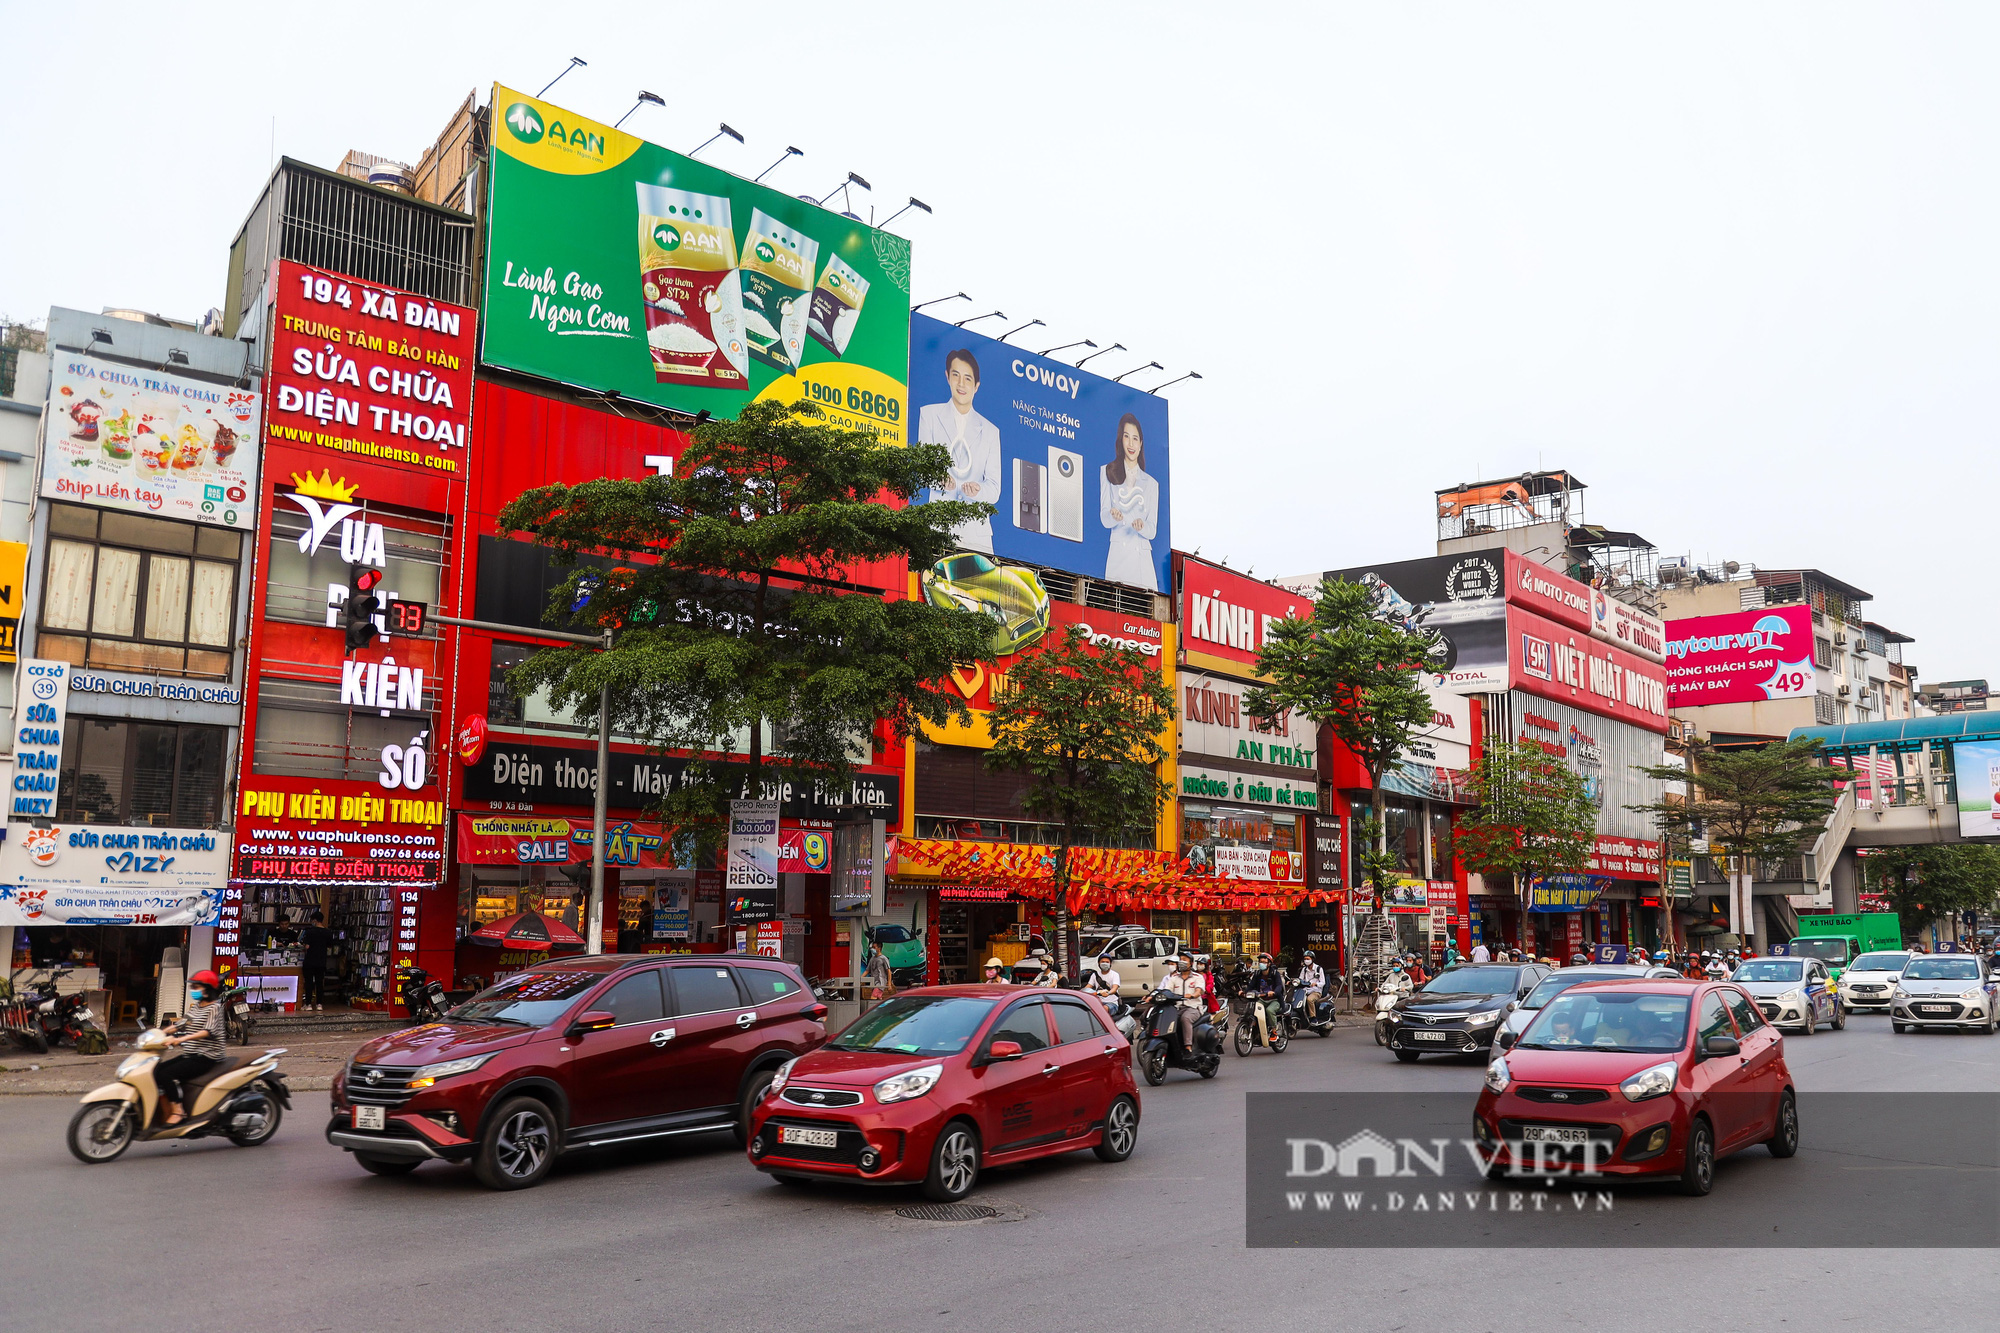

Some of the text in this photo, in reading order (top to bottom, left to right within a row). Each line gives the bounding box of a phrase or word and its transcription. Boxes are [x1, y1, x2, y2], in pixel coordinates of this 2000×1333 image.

[548, 120, 605, 156] AAN
[683, 230, 722, 250] AAN
[776, 253, 804, 275] AAN
[502, 261, 603, 301] Lành Gạo
[666, 287, 690, 301] ST24
[841, 284, 860, 301] AAN
[301, 274, 460, 336] 194 XÃ ĐÀN
[529, 293, 630, 332] Ngon Cơm
[283, 314, 459, 371] TRUNG TÂM BẢO HÀN
[68, 363, 221, 404] SỮA CHUA TRÂN CHÂU
[292, 343, 454, 409] SỬA CHỮA
[802, 380, 900, 421] 1900 6869
[277, 384, 465, 451] ĐIỆN THOẠI
[1012, 400, 1080, 428] NÂNG TẦM SỐNG
[829, 415, 852, 428] GẠO
[883, 429, 899, 441] PHÍ
[1019, 415, 1075, 440] TRỌN AN TÂM
[56, 478, 193, 510] Ship Liền tay cùng
[1464, 558, 1479, 567] 2017
[1462, 570, 1481, 580] MOTO2
[1457, 588, 1487, 597] CHAMPIONS
[1463, 580, 1481, 589] WORLD
[1534, 578, 1588, 614] MOTO ZONE
[393, 603, 421, 631] 73
[1191, 589, 1254, 652] KÍNH
[1123, 622, 1160, 638] Car Audio
[1530, 641, 1547, 669] SH
[1705, 661, 1746, 674] KHÁCH
[1750, 659, 1773, 671] SẠN
[1449, 672, 1487, 681] TOTAL
[1554, 637, 1665, 717] VIỆT NHẬT MOTOR
[37, 683, 53, 694] 39
[72, 674, 241, 704] SỮA CHUA TRÂN CHÂU
[341, 657, 424, 717] KIỆN
[1680, 681, 1705, 692] MÁY
[1708, 679, 1731, 690] BAY
[26, 703, 57, 723] SỮA
[19, 728, 60, 746] CHUA
[18, 750, 58, 770] TRÂN
[378, 730, 430, 791] SỐ
[1236, 740, 1314, 768] AN PHÁT
[14, 772, 56, 792] CHÂU
[493, 753, 543, 794] Điện
[555, 757, 598, 798] thoạ
[633, 764, 673, 800] Máy
[852, 781, 885, 816] kiện
[1183, 774, 1316, 807] KHÔNG Ở ĐÂU RẺ HƠN
[14, 798, 53, 814] MIZY
[242, 788, 444, 831] PHỤ KIỆN ĐIỆN THOẠI
[489, 801, 533, 812] 190 Xã Đàn
[733, 801, 778, 809] OPPO Reno5
[69, 829, 215, 851] SỮA CHUA TRÂN CHÂU
[252, 829, 436, 846] www. vuaphukienso.com
[239, 843, 441, 860] Cơ sở 194 Xã Đàn 0967 68 6666
[519, 842, 567, 859] SALE
[1217, 850, 1267, 863] MUA BÁN SỬA CHỮA
[1599, 840, 1612, 855] BẢO
[1612, 841, 1633, 857] DƯỠNG
[1271, 855, 1287, 865] ĐỒNG
[252, 859, 425, 881] PHỤ KIỆN ĐIỆN THOẠI
[1276, 866, 1285, 877] HỒ
[729, 873, 775, 885] RENO5
[400, 891, 418, 902] 194
[951, 888, 1008, 899] PHIM CÁCH NHIỆT
[222, 907, 239, 917] PHỤ
[403, 906, 416, 917] PHỤ
[219, 919, 239, 930] KIỆN
[401, 918, 416, 928] KIỆN
[1809, 919, 1819, 927] XE
[1820, 918, 1835, 926] THƯ
[218, 932, 238, 944] ĐIỆN
[400, 930, 415, 940] ĐIỆN
[215, 946, 239, 957] THOẠI
[1602, 947, 1617, 962] G7
